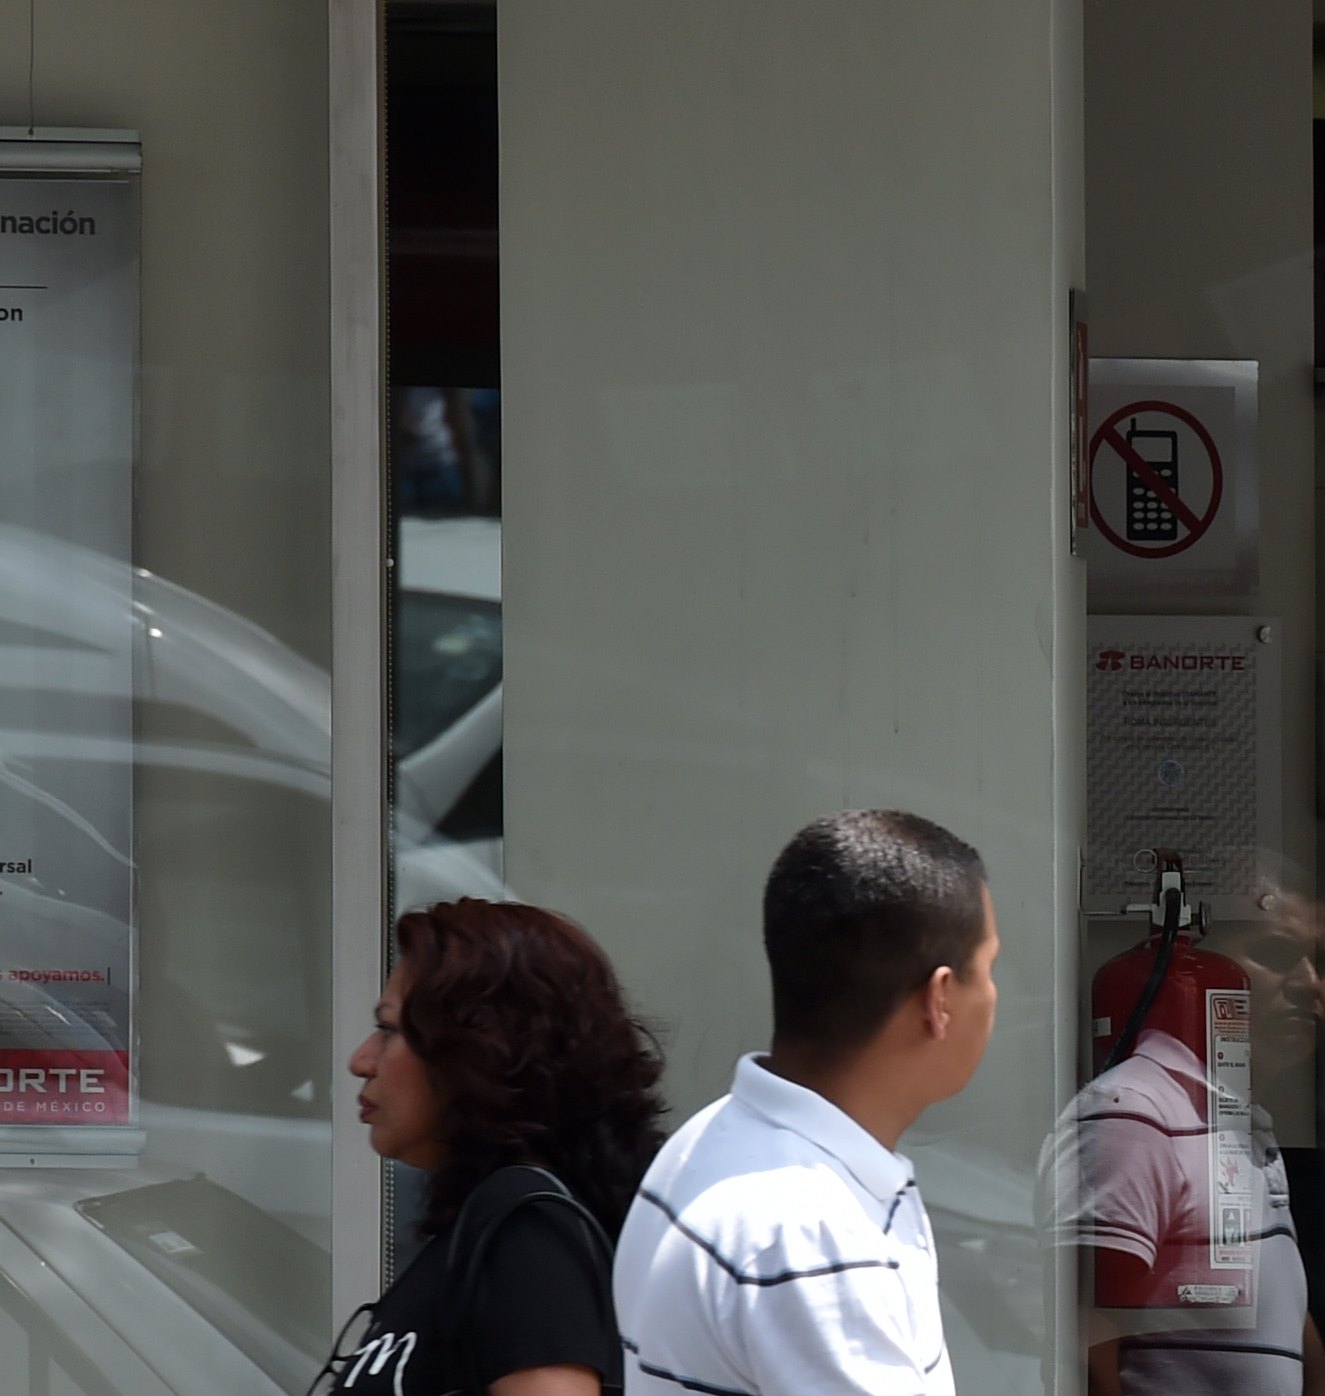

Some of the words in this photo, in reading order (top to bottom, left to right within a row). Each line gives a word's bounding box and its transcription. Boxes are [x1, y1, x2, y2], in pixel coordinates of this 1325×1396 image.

[1, 210, 95, 235] nación
[1130, 655, 1245, 670] BANORTE
[9, 969, 104, 984] apoyamos.
[4, 1102, 25, 1112] DE
[36, 1100, 105, 1112] MÉXICO
